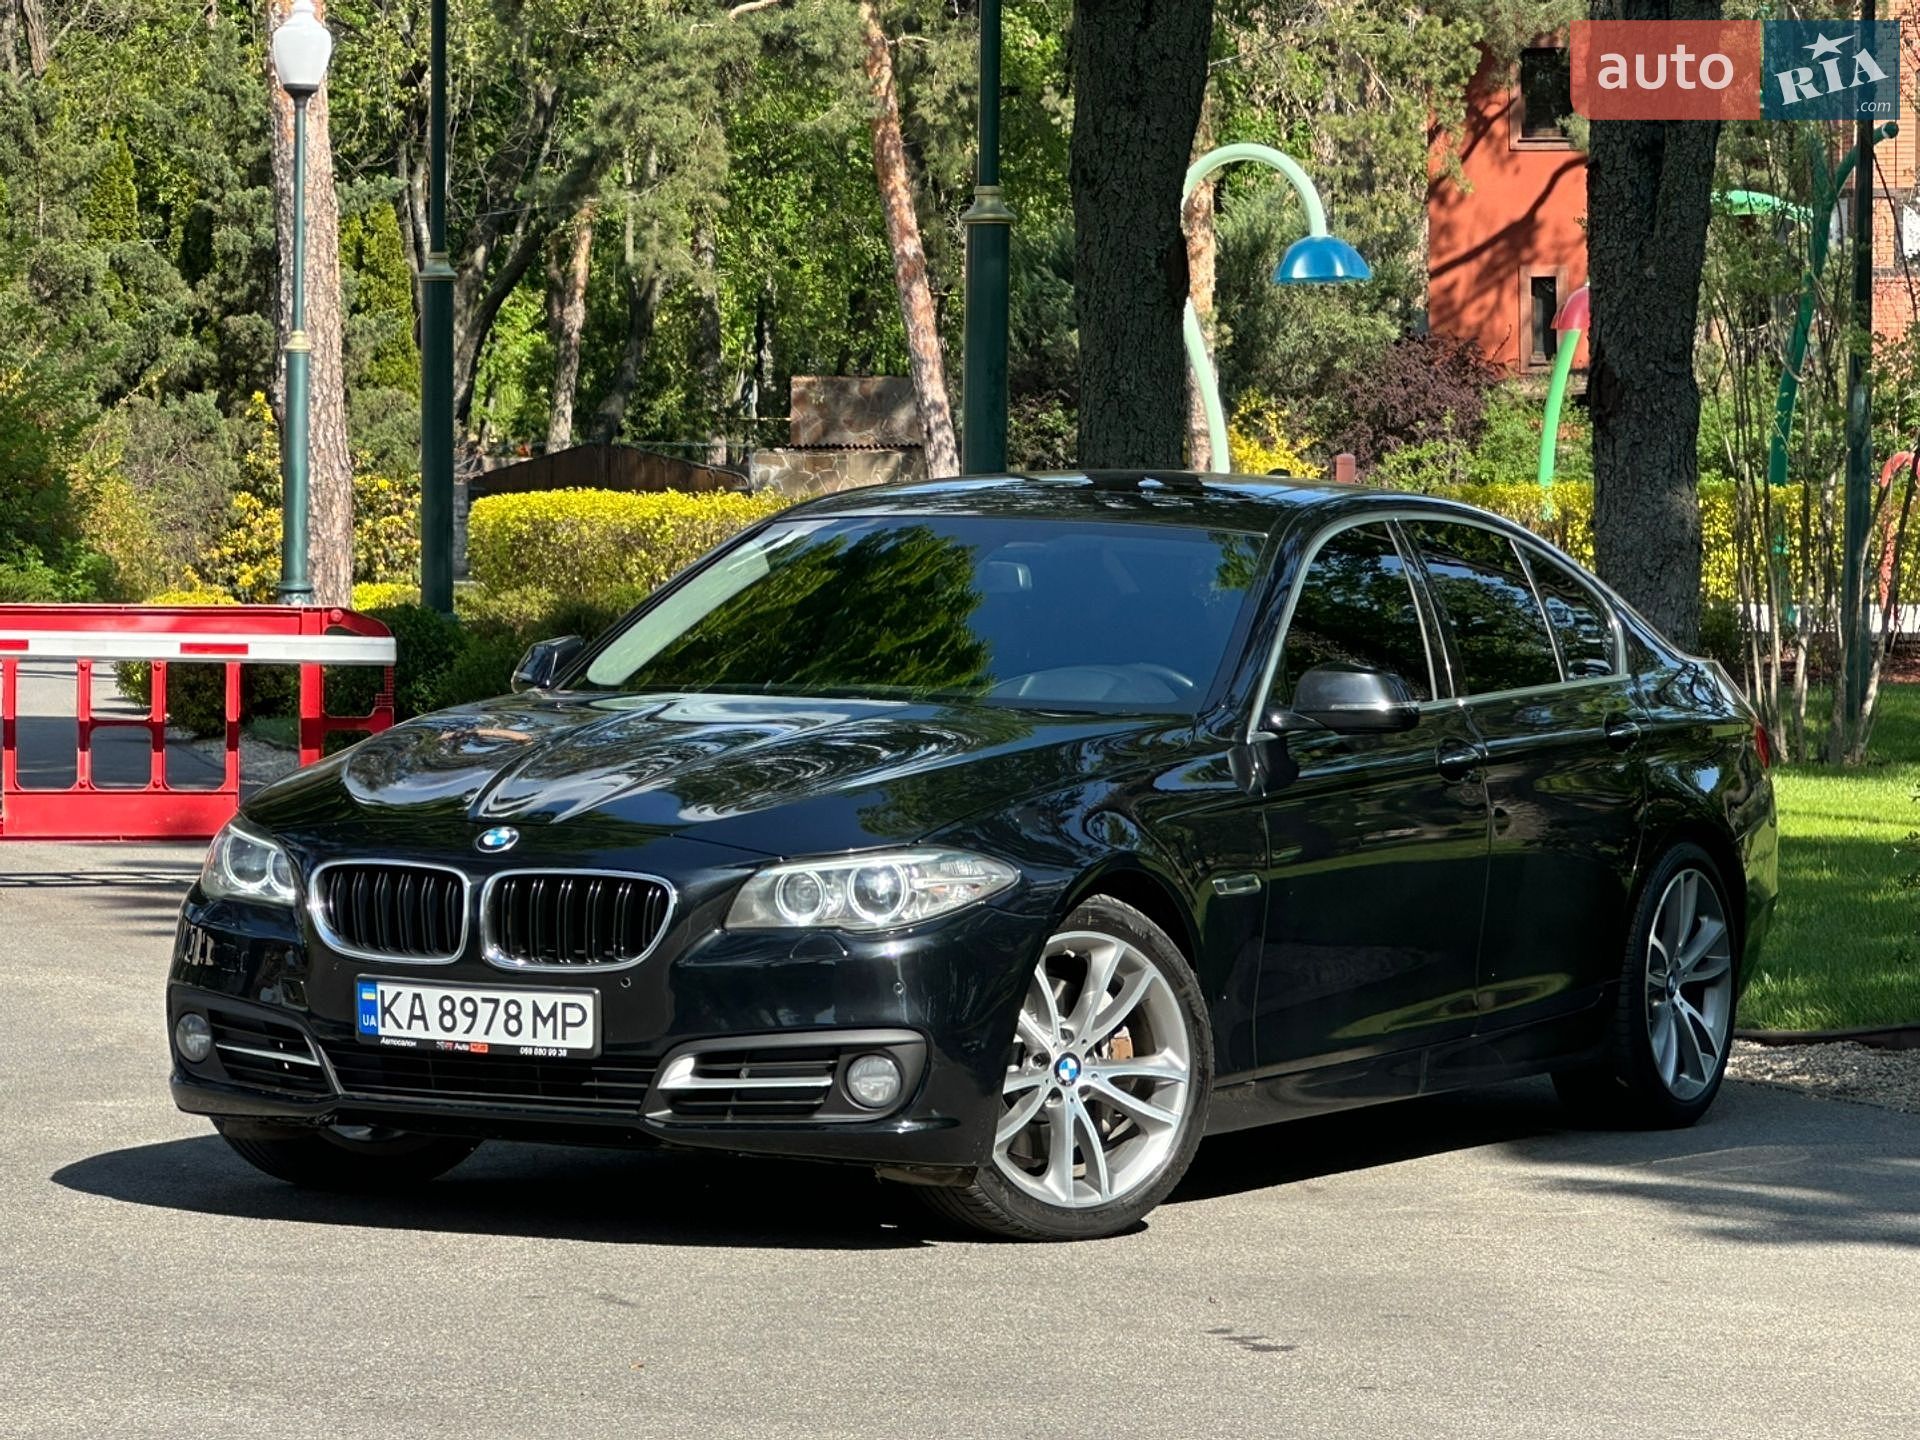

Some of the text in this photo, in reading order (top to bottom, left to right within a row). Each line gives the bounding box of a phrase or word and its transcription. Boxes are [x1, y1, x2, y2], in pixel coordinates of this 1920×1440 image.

[362, 1014, 377, 1027] UA
[379, 989, 588, 1041] KA 8978 MP
